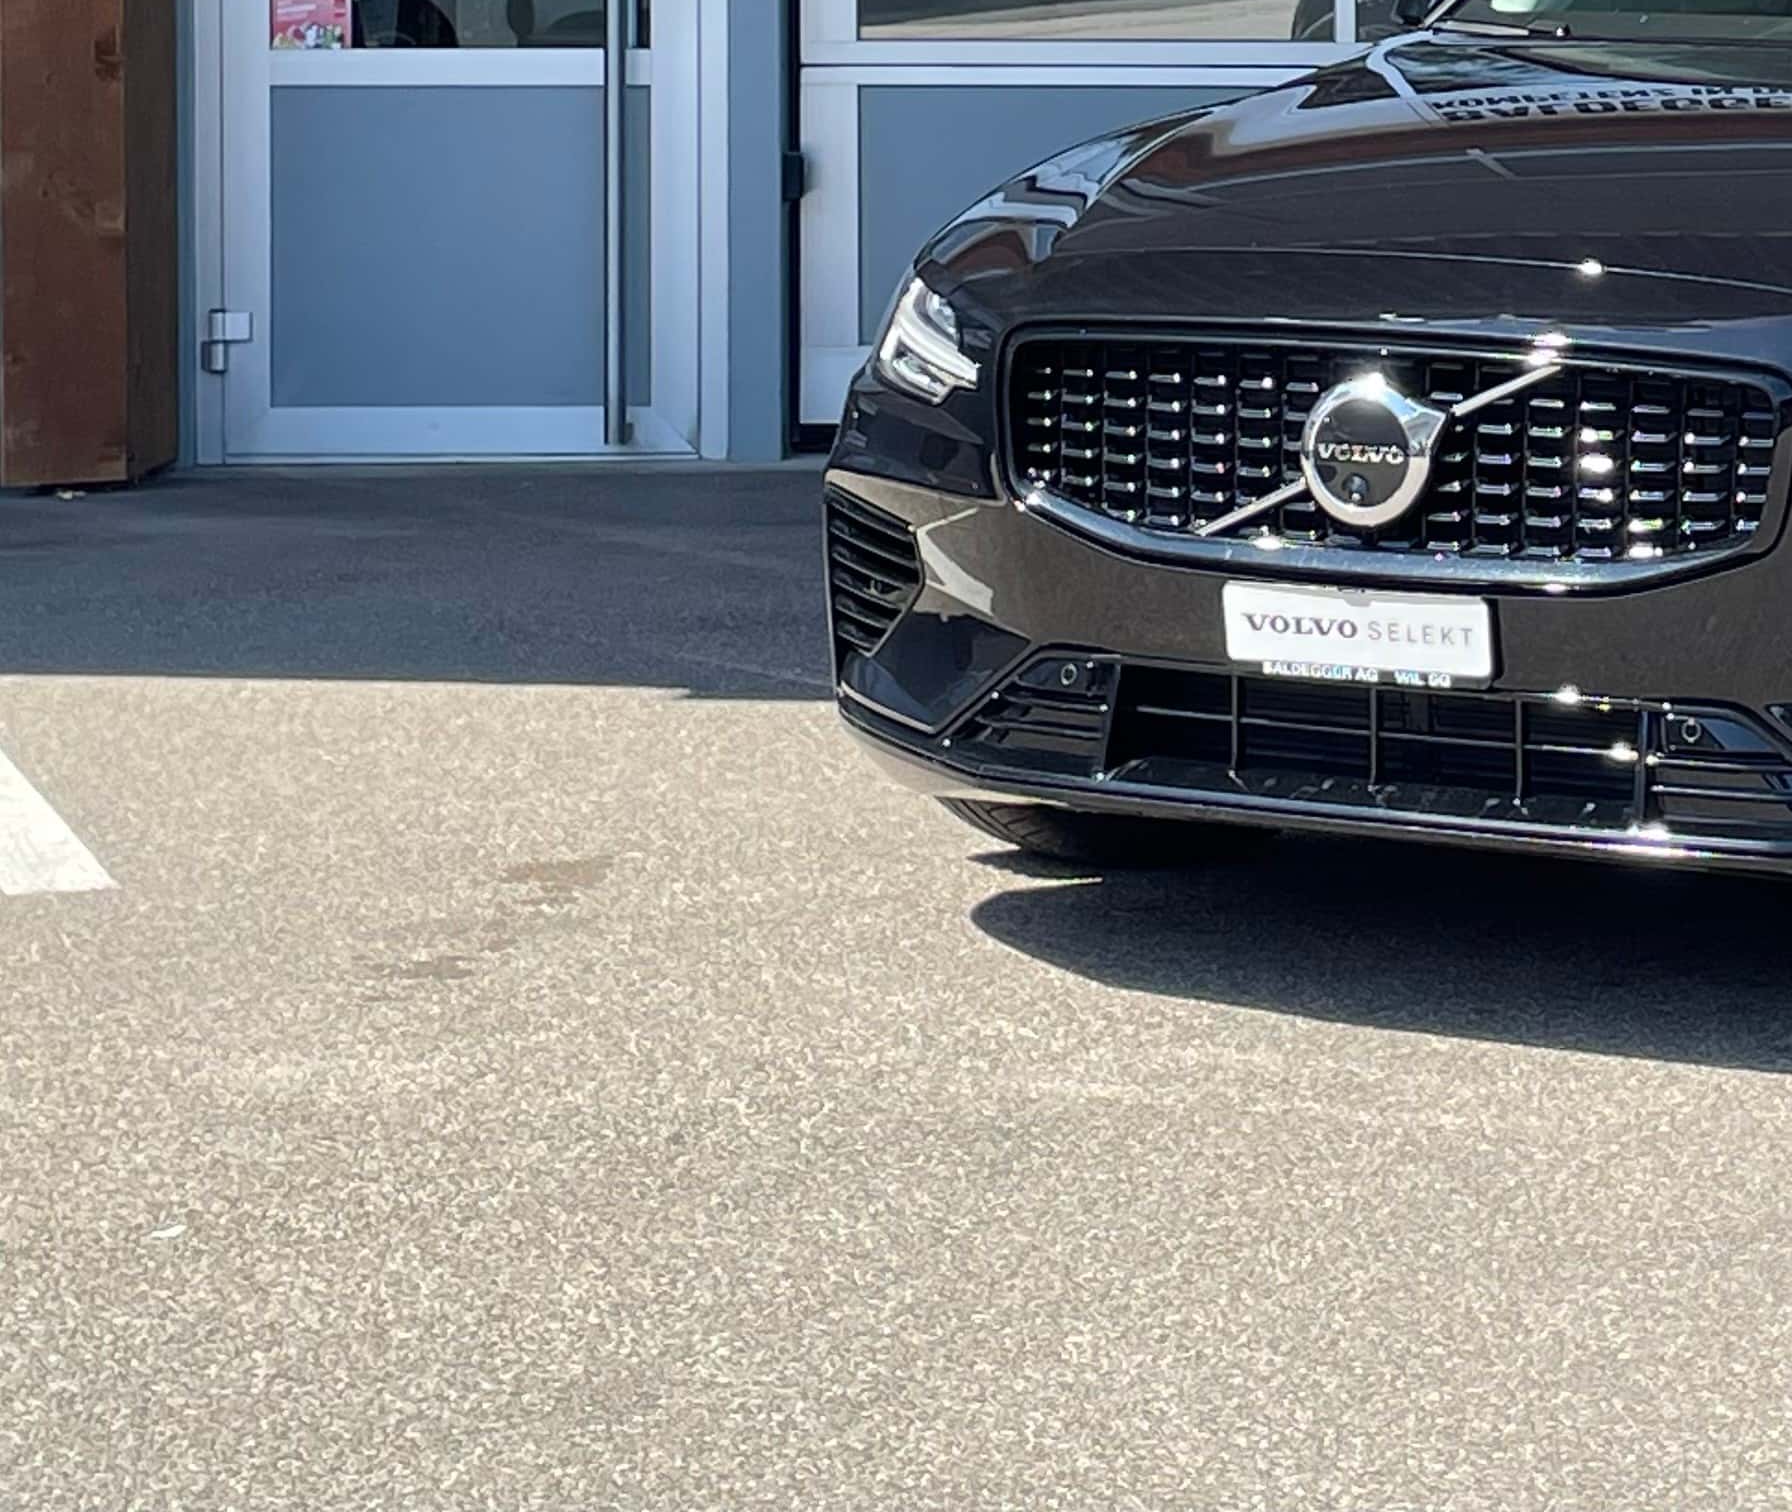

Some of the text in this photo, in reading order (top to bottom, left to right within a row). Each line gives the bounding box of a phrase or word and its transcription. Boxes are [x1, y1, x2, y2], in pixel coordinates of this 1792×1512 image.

[1317, 441, 1405, 465] VOLVO
[1243, 613, 1473, 646] VOLVO SELEKT
